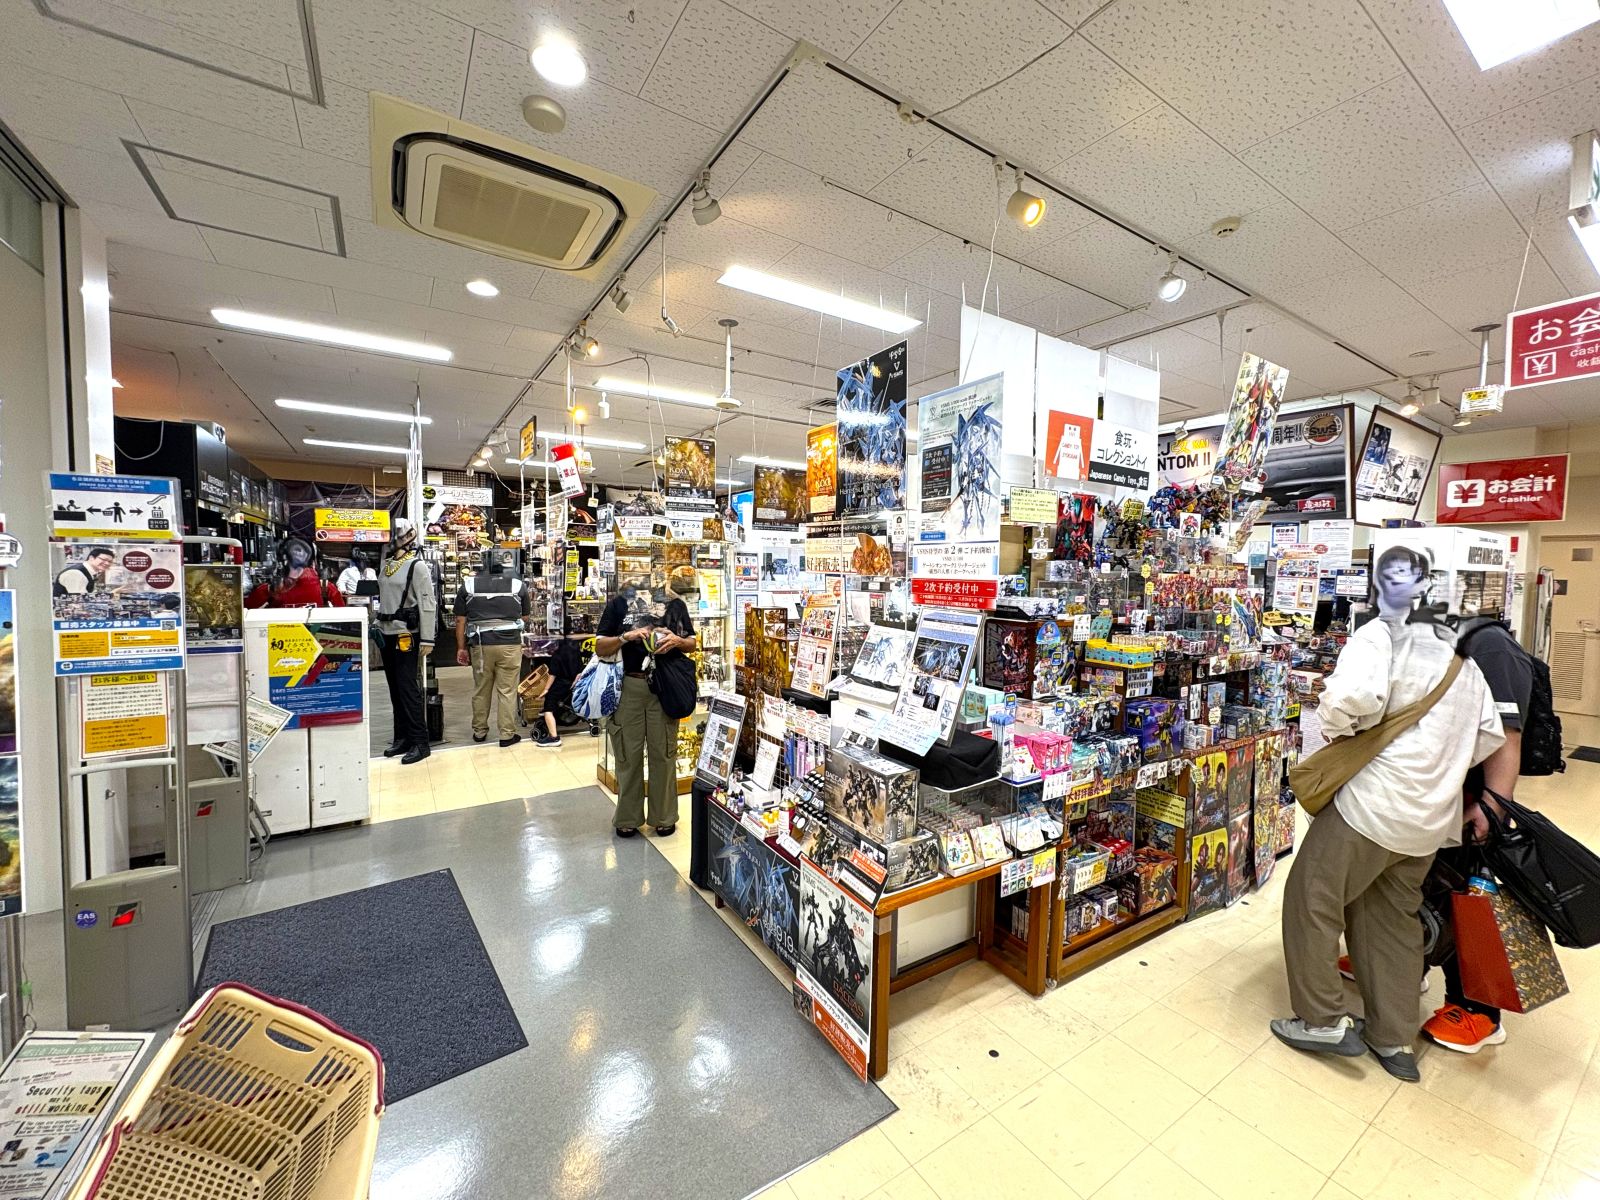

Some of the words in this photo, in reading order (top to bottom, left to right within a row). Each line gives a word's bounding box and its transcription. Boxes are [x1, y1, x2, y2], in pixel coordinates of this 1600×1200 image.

[1097, 448, 1147, 469] コレクショントイ
[1089, 470, 1112, 480] Japanese
[1113, 473, 1126, 484] Candy
[1488, 474, 1557, 494] お会計
[1498, 495, 1544, 503] Cashier
[924, 582, 979, 595] 2次予約受付中
[60, 620, 140, 629] 販売スタッフ募集中
[270, 637, 284, 651] 初
[93, 675, 155, 684] お客様へお願い
[26, 1085, 75, 1096] Security
[80, 1086, 103, 1095] tags
[15, 1104, 44, 1114] still
[48, 1102, 88, 1113] working
